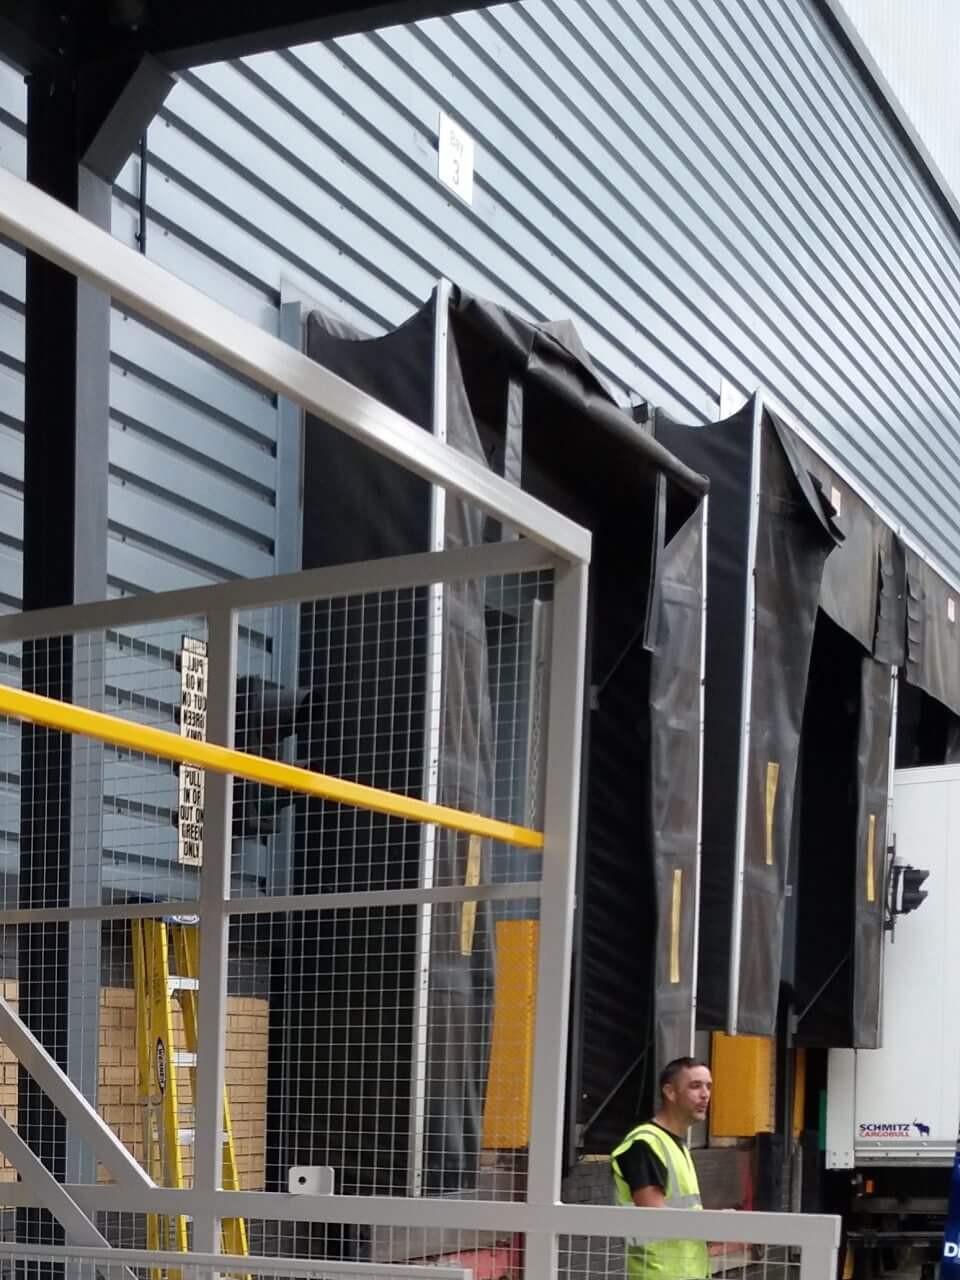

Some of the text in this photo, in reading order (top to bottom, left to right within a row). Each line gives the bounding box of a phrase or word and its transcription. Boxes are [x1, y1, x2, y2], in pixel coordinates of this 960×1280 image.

[185, 769, 201, 788] PULL
[183, 787, 191, 803] IN
[181, 805, 193, 821] OUT
[183, 841, 200, 858] ONLY
[859, 1123, 911, 1132] SCHMITZ
